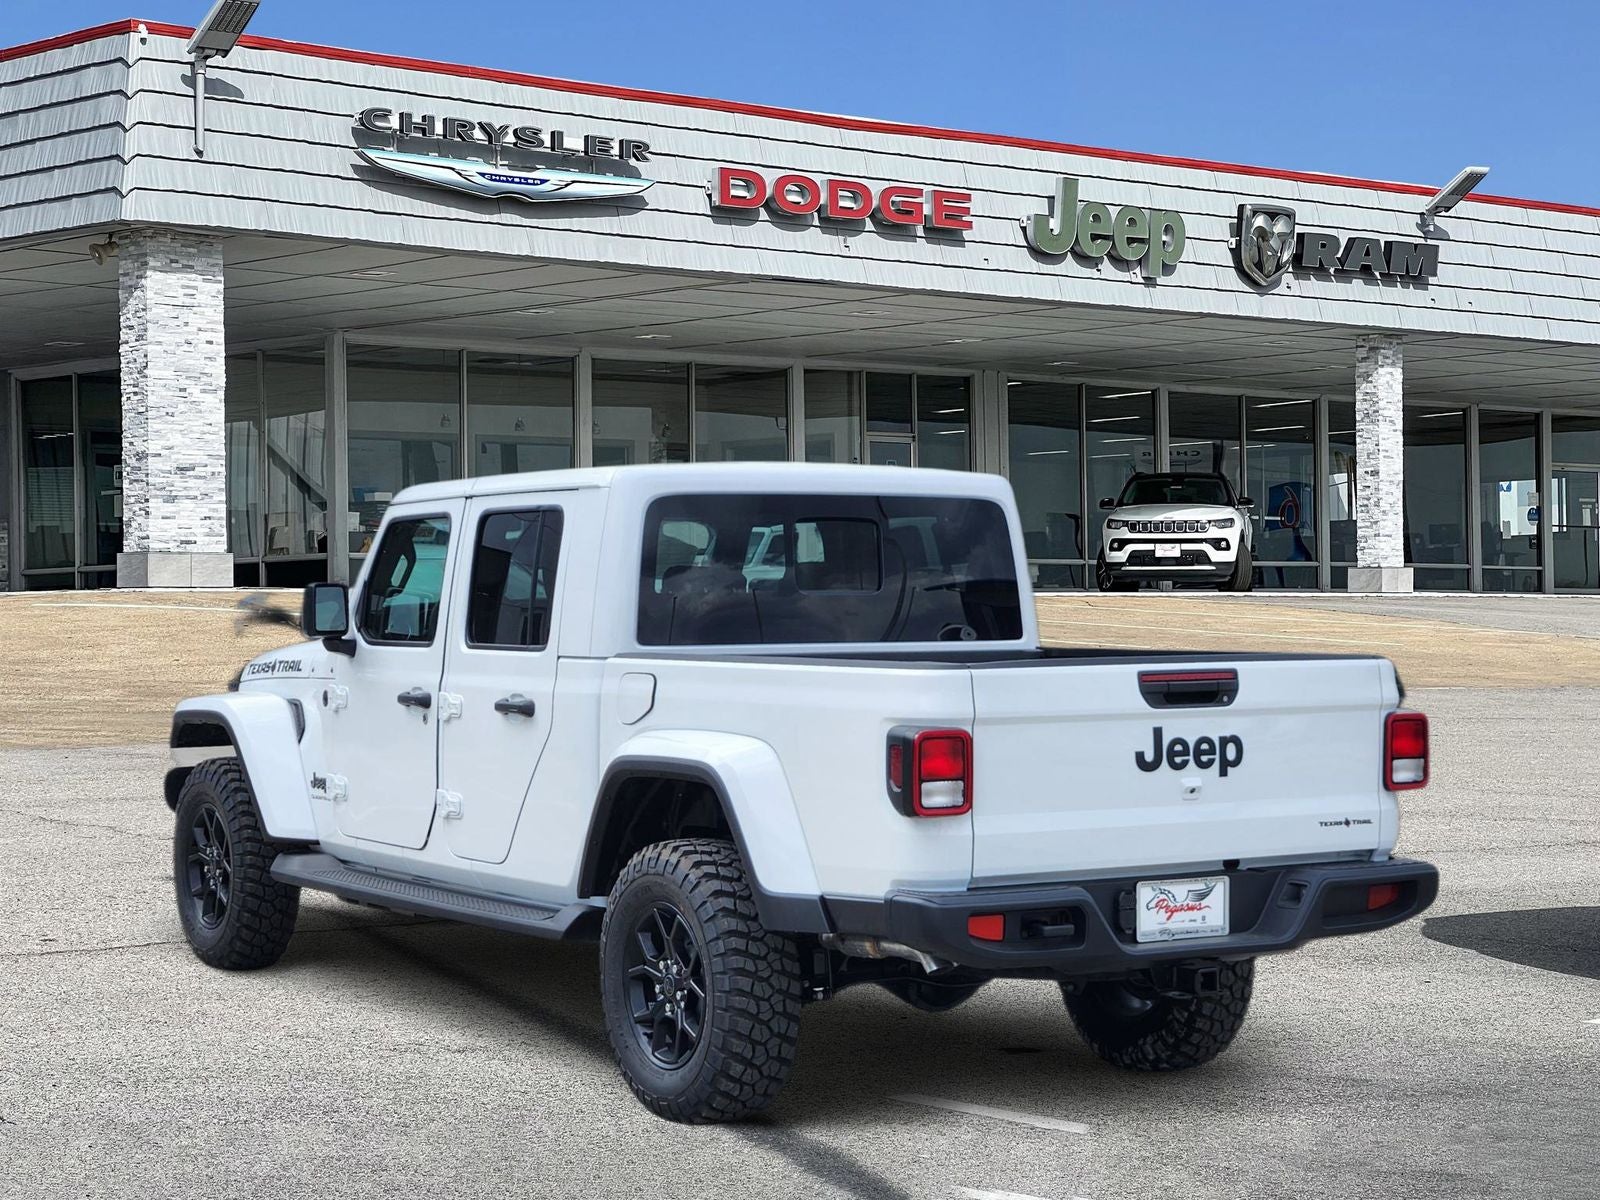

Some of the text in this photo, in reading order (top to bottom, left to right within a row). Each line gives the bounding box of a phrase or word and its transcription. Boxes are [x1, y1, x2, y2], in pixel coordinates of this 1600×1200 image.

[358, 106, 652, 163] CHRYSLER
[484, 174, 541, 185] CHRYSLER
[712, 166, 974, 231] DODGE
[1026, 177, 1186, 278] Jeep
[1300, 232, 1440, 277] RAM
[277, 660, 302, 672] TRAIL
[1135, 726, 1244, 777] Jeep
[1155, 898, 1210, 921] Pegasus
